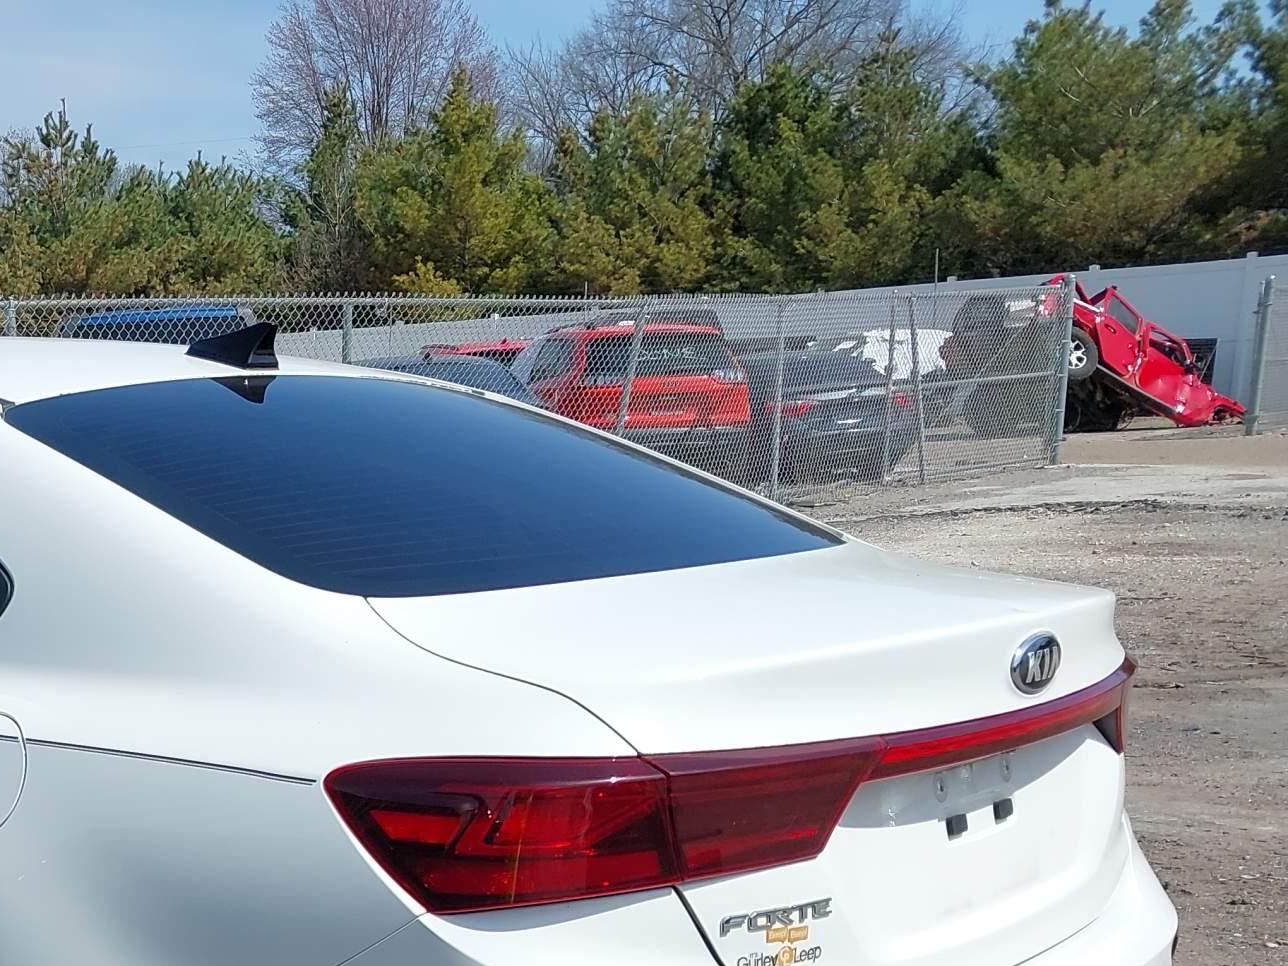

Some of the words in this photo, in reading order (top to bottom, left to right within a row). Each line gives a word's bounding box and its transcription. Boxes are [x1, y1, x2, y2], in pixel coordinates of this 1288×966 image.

[1025, 646, 1060, 683] KIA
[719, 897, 833, 938] FORTE
[793, 945, 822, 963] Leep
